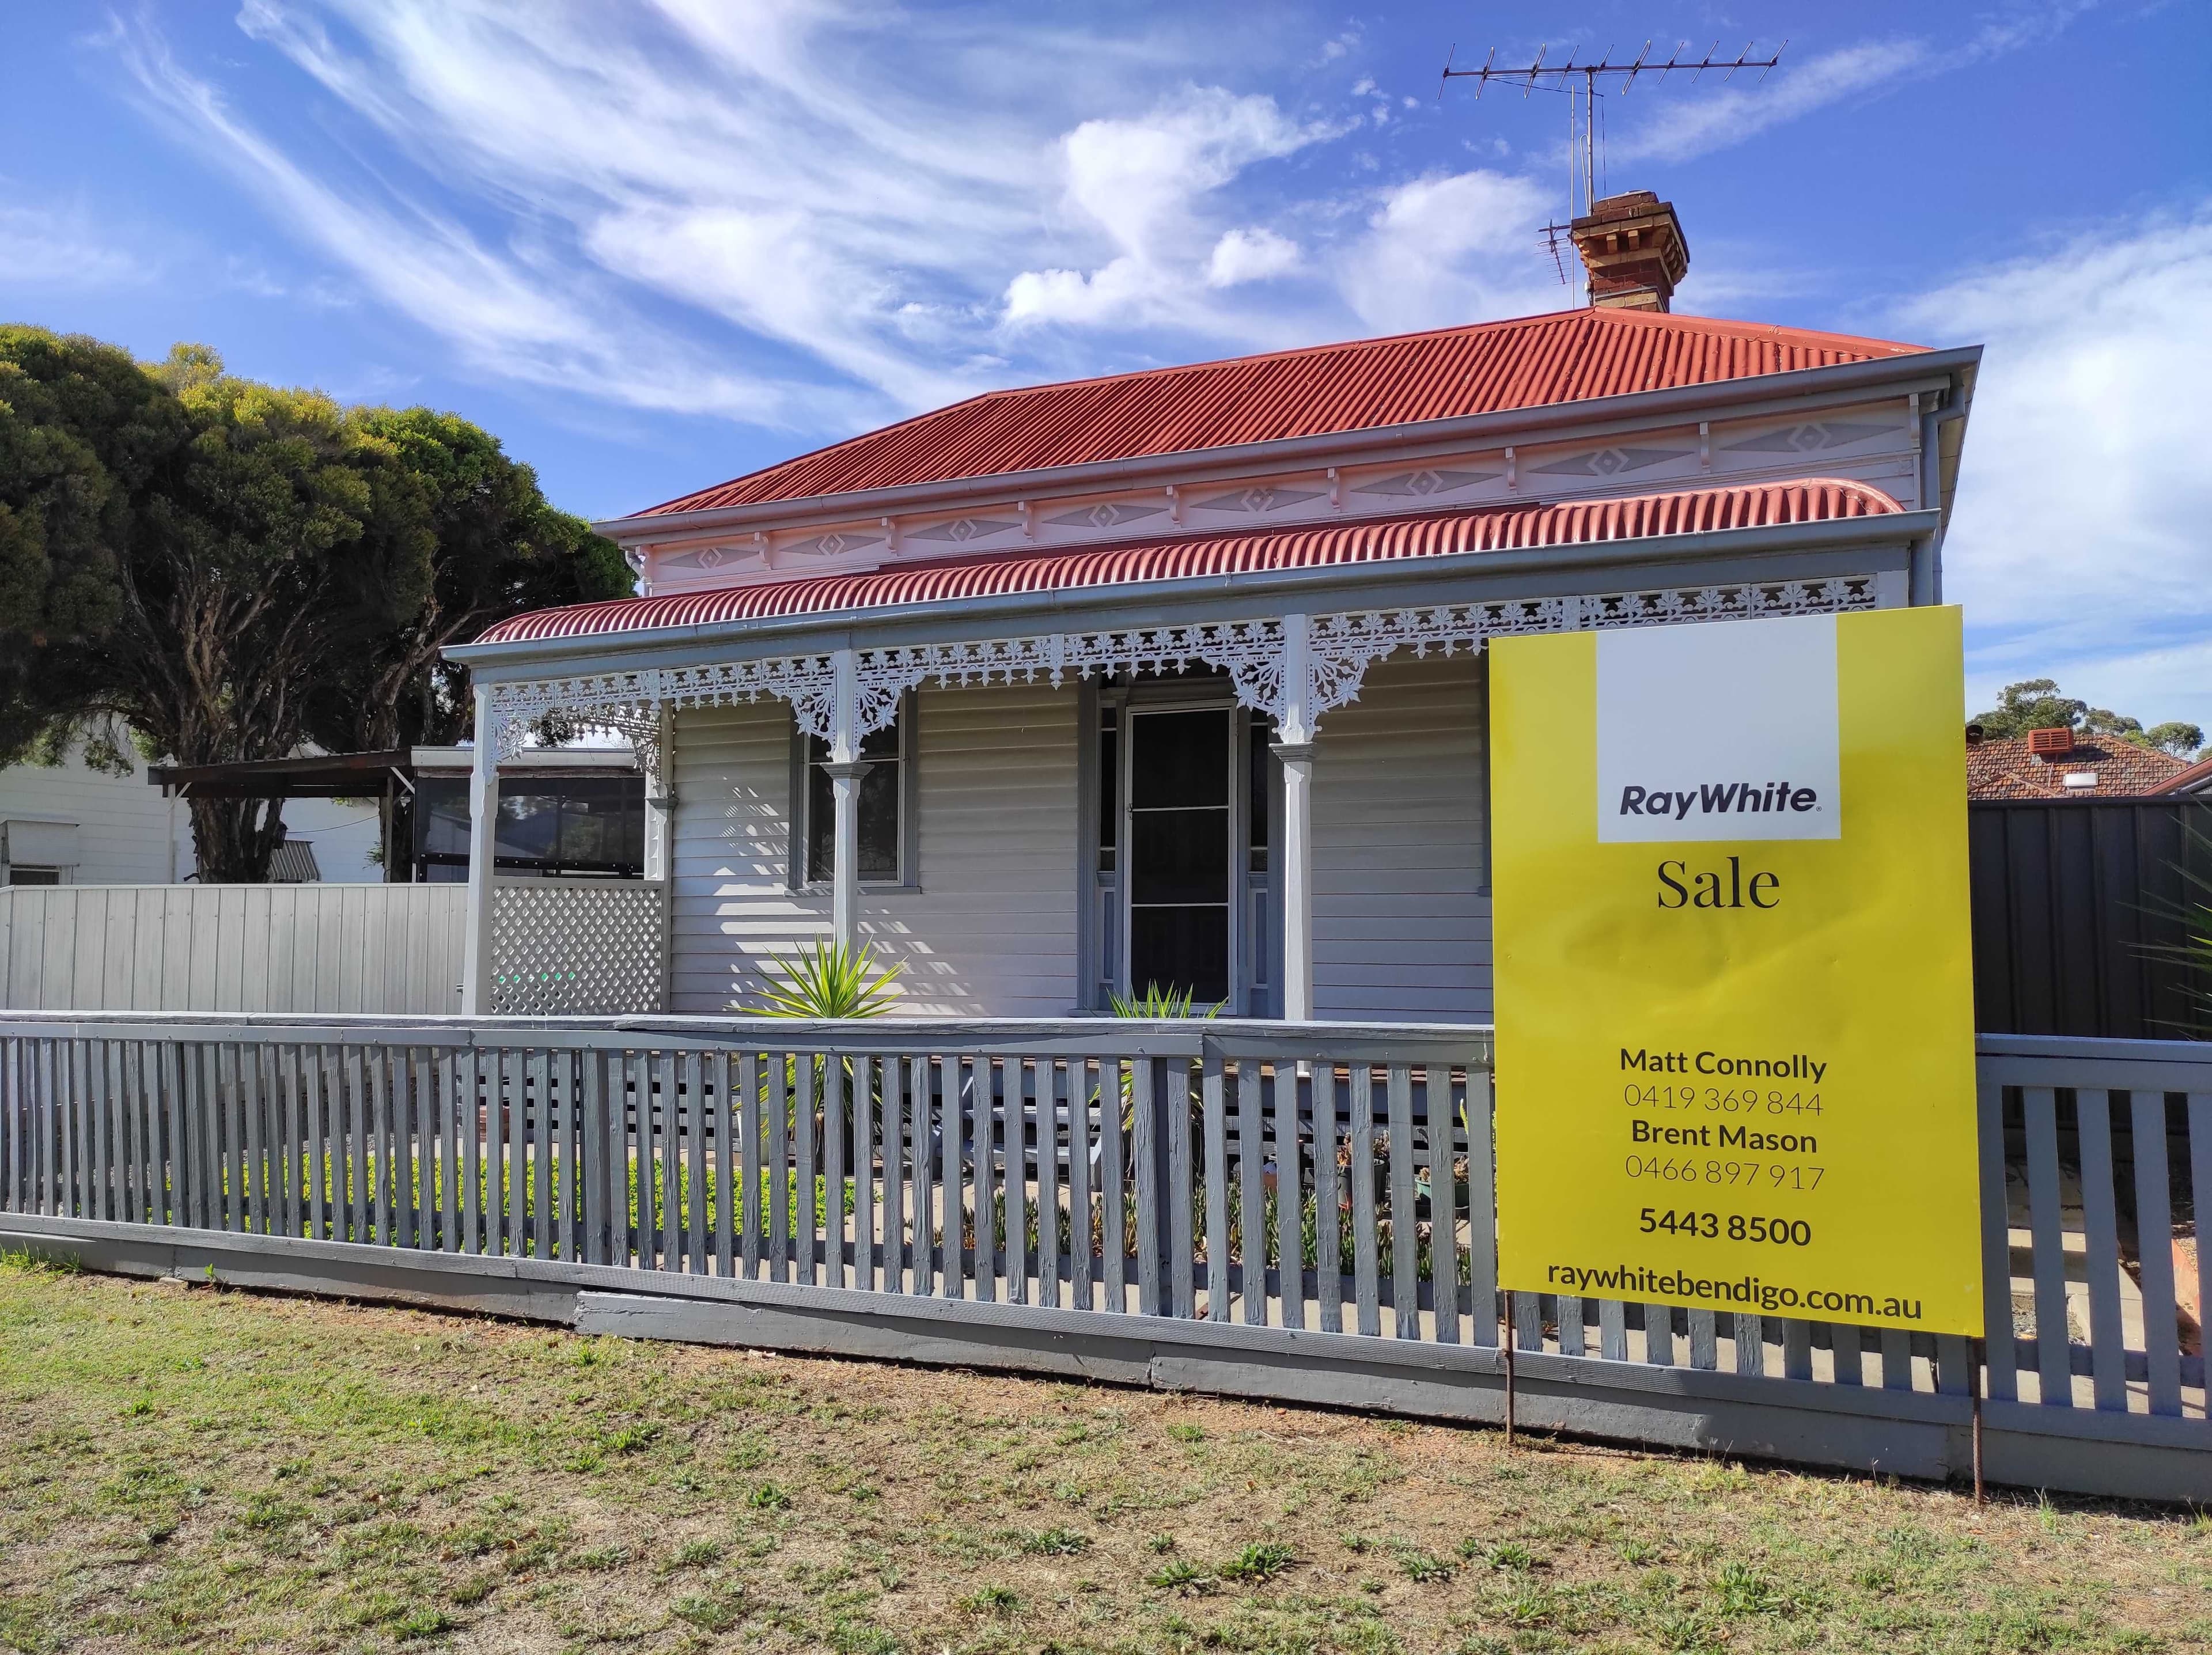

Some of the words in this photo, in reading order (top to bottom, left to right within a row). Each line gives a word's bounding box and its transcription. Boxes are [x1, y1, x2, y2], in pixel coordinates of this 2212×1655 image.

[1658, 856, 1780, 908] Sale
[1620, 1048, 1688, 1073] Matt
[1695, 1051, 1827, 1084] Connolly
[1624, 1084, 1695, 1109] 0419
[1705, 1088, 1758, 1112] 369
[1768, 1092, 1824, 1116] 844
[1633, 1120, 1711, 1146] Brent
[1719, 1125, 1816, 1153] Mason
[1626, 1156, 1696, 1181] 0466
[1706, 1161, 1759, 1186] 897
[1770, 1165, 1824, 1190] 917
[1639, 1208, 1718, 1238] 5443
[1728, 1215, 1811, 1246] 8500
[1548, 1264, 1921, 1319] raywhitebendigo.com.au
